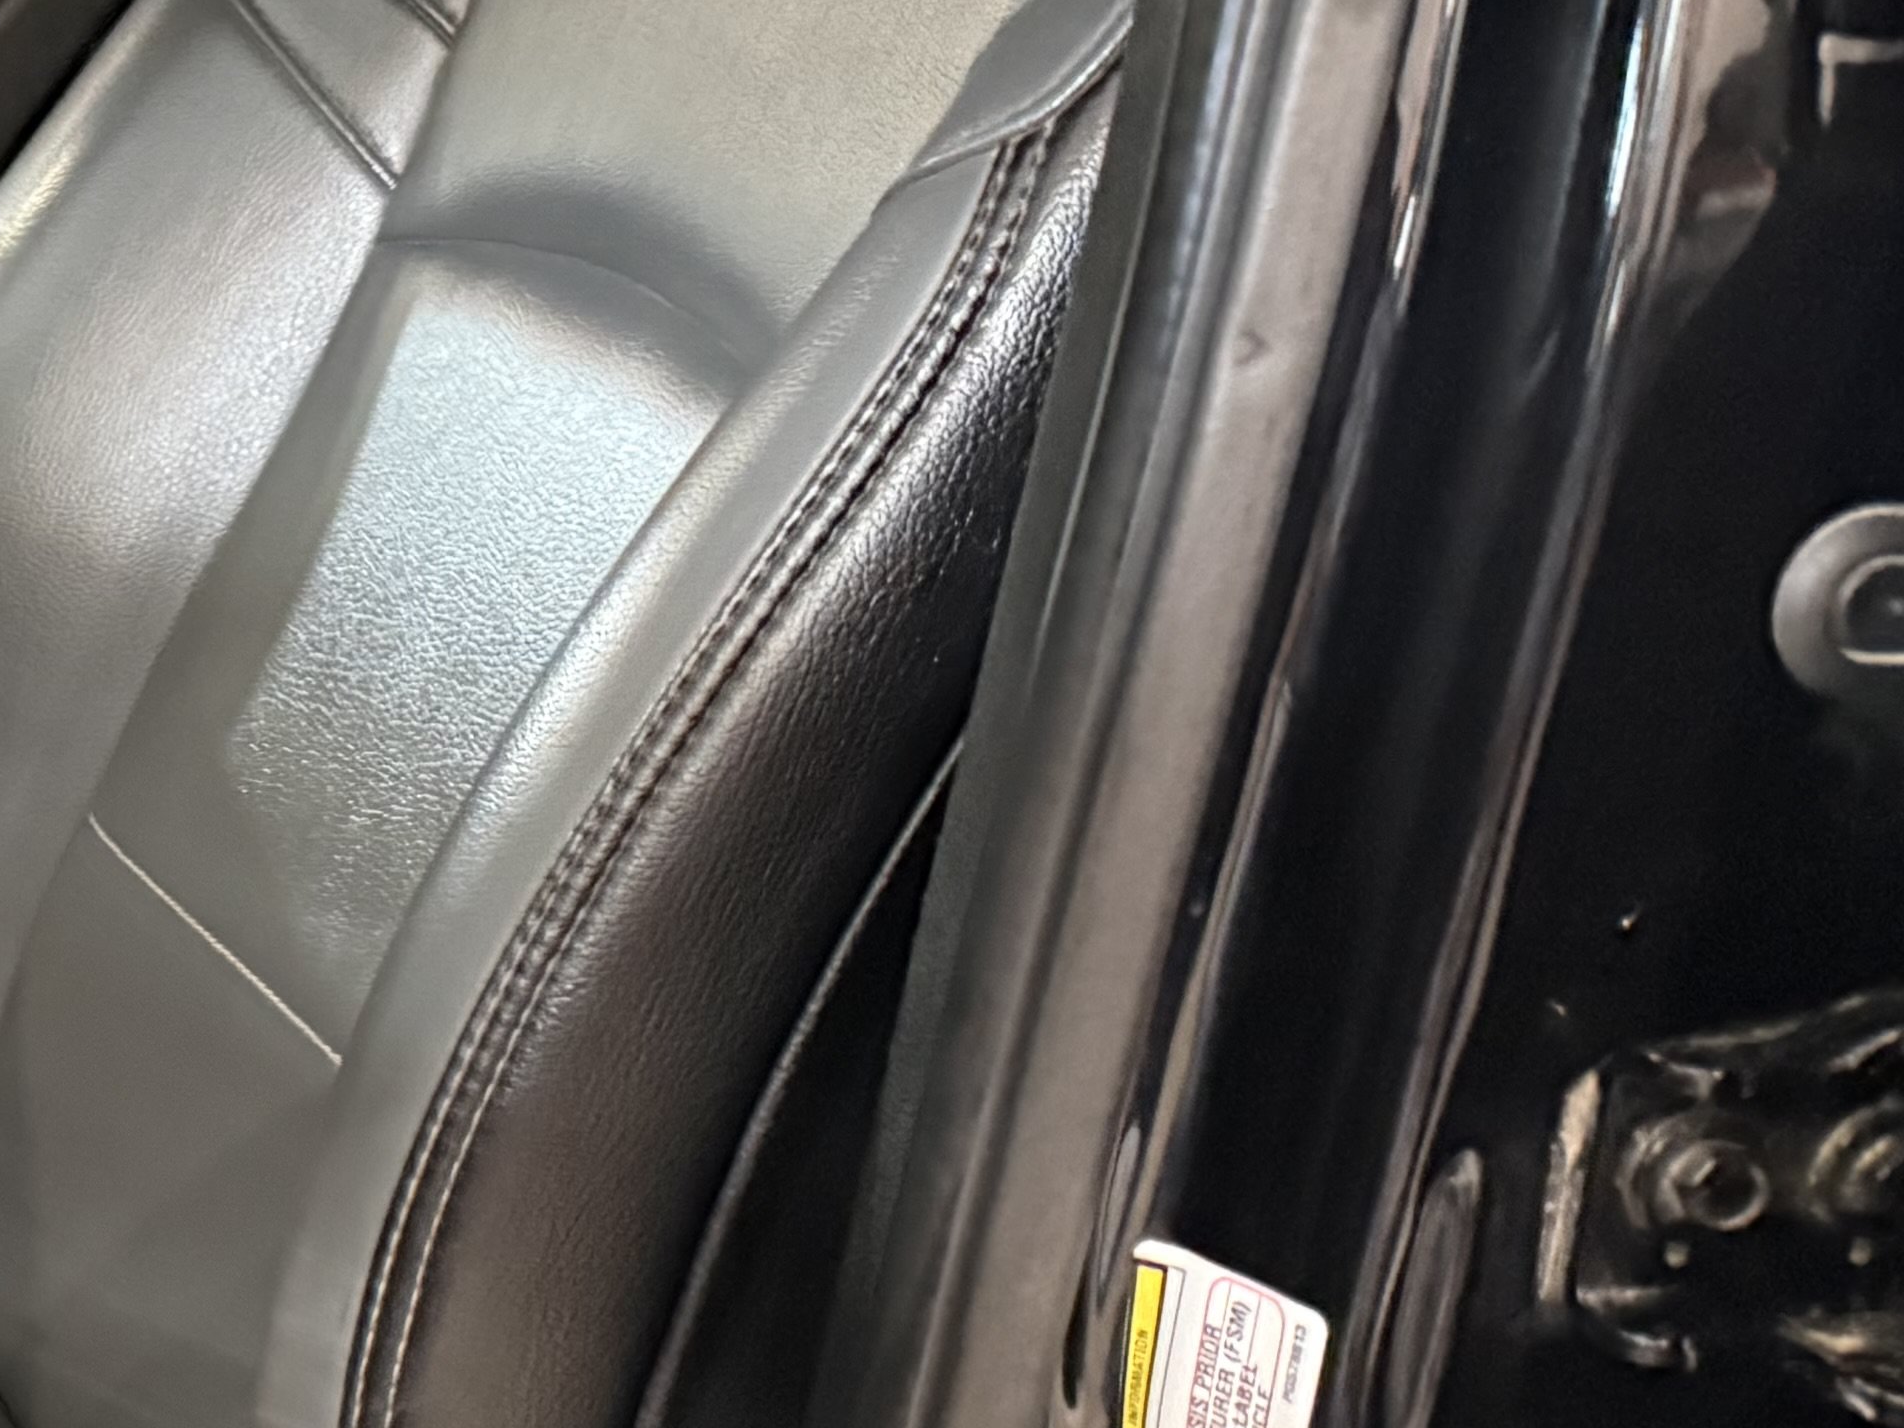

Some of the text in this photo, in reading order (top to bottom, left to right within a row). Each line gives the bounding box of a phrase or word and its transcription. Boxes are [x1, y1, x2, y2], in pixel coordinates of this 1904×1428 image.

[1195, 1323, 1221, 1391] PRIOR
[1223, 1300, 1251, 1363] (FSM)
[1128, 1328, 1148, 1426] INFORMATION
[1232, 1363, 1257, 1428] LABEL
